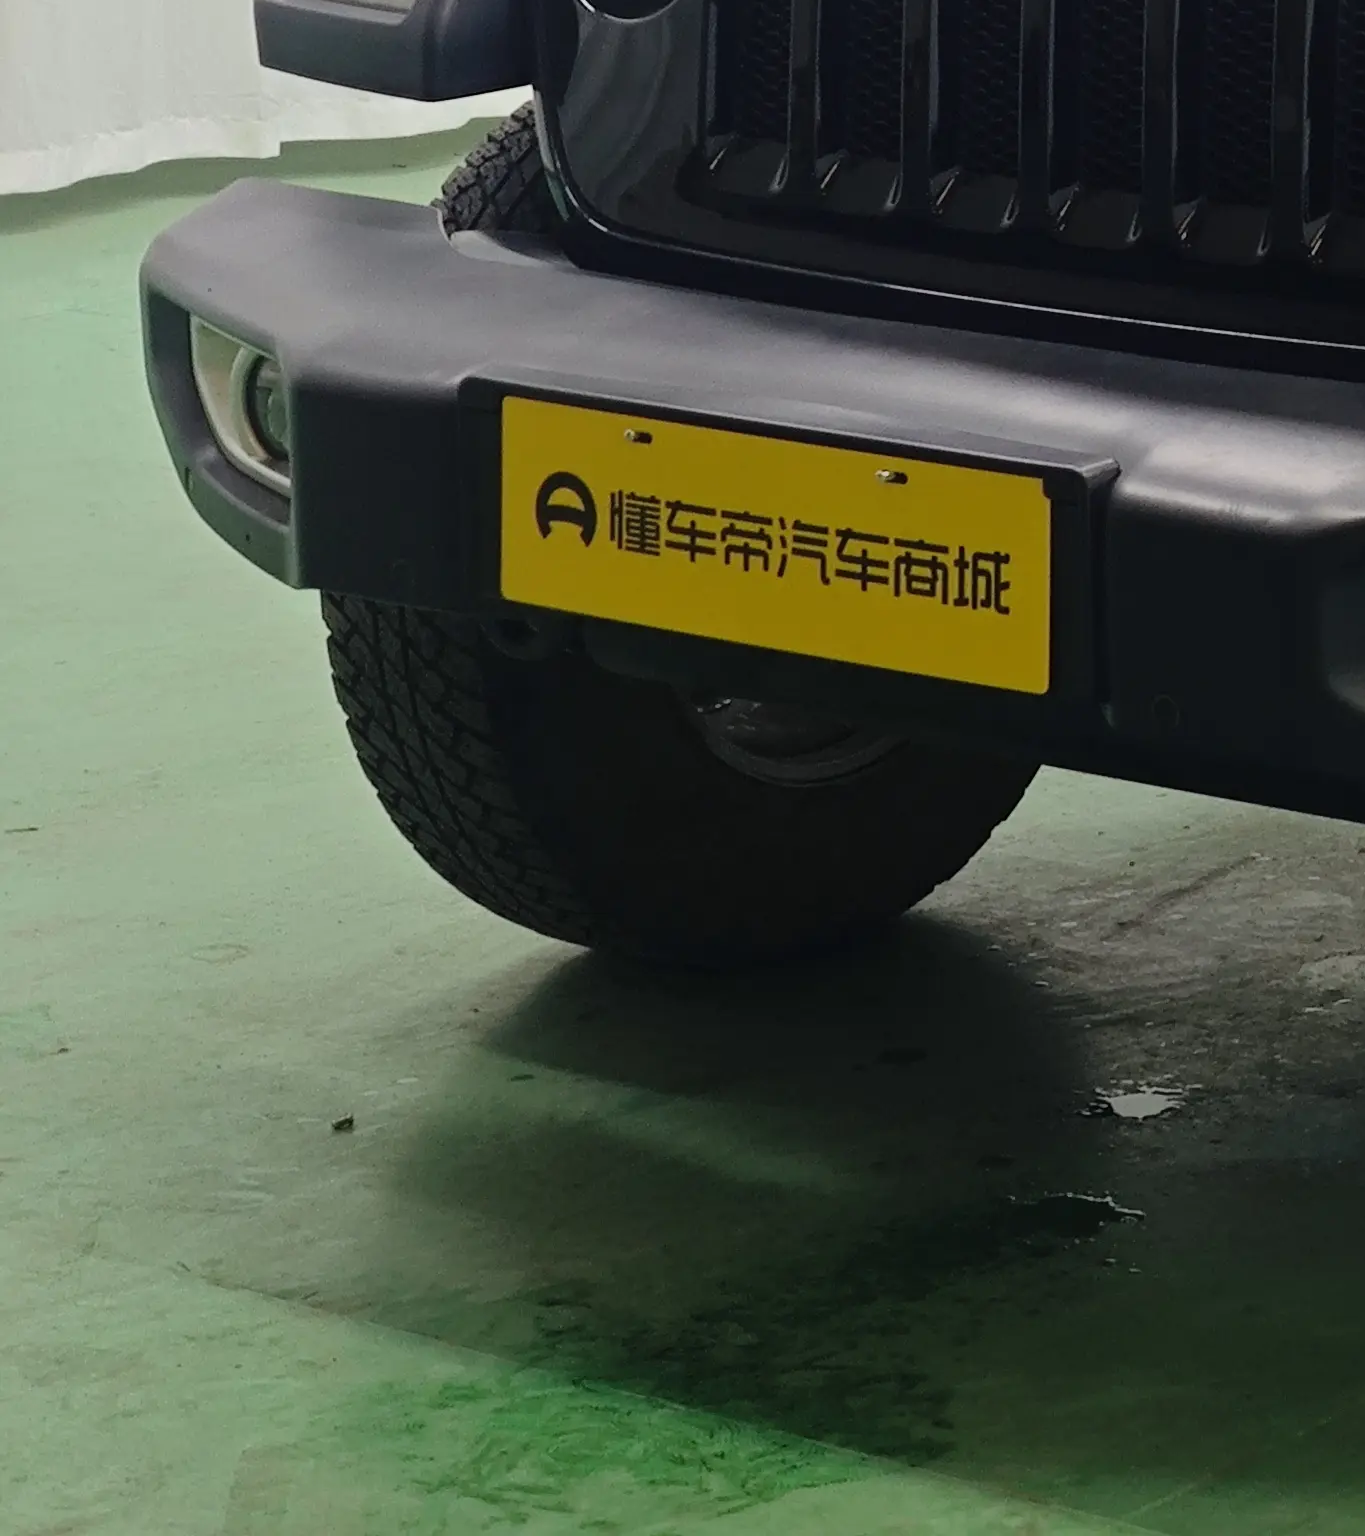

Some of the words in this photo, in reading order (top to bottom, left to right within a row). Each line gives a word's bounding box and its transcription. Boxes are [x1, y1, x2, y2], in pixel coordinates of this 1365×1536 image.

[609, 488, 1012, 616] 懂车帝汽车商城
